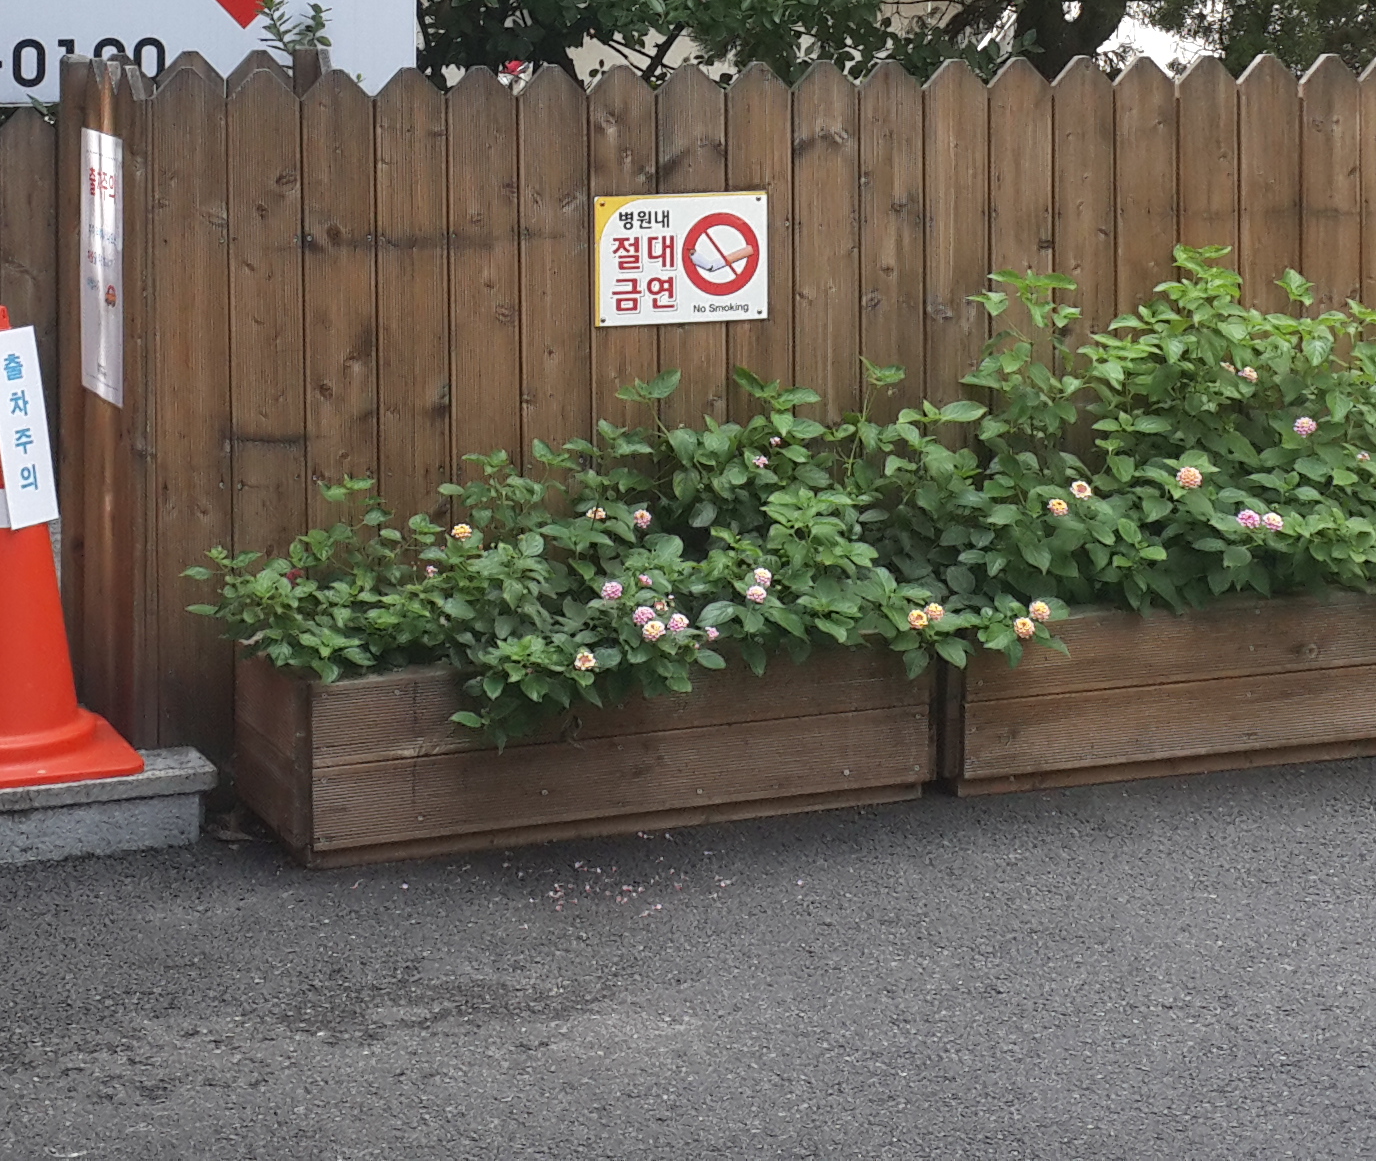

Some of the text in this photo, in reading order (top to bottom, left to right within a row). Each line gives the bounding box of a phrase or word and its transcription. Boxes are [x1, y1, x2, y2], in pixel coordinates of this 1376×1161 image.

[618, 210, 670, 230] 병원내
[612, 235, 675, 270] 절대
[611, 276, 675, 312] 금연
[693, 303, 749, 313] No Smoking
